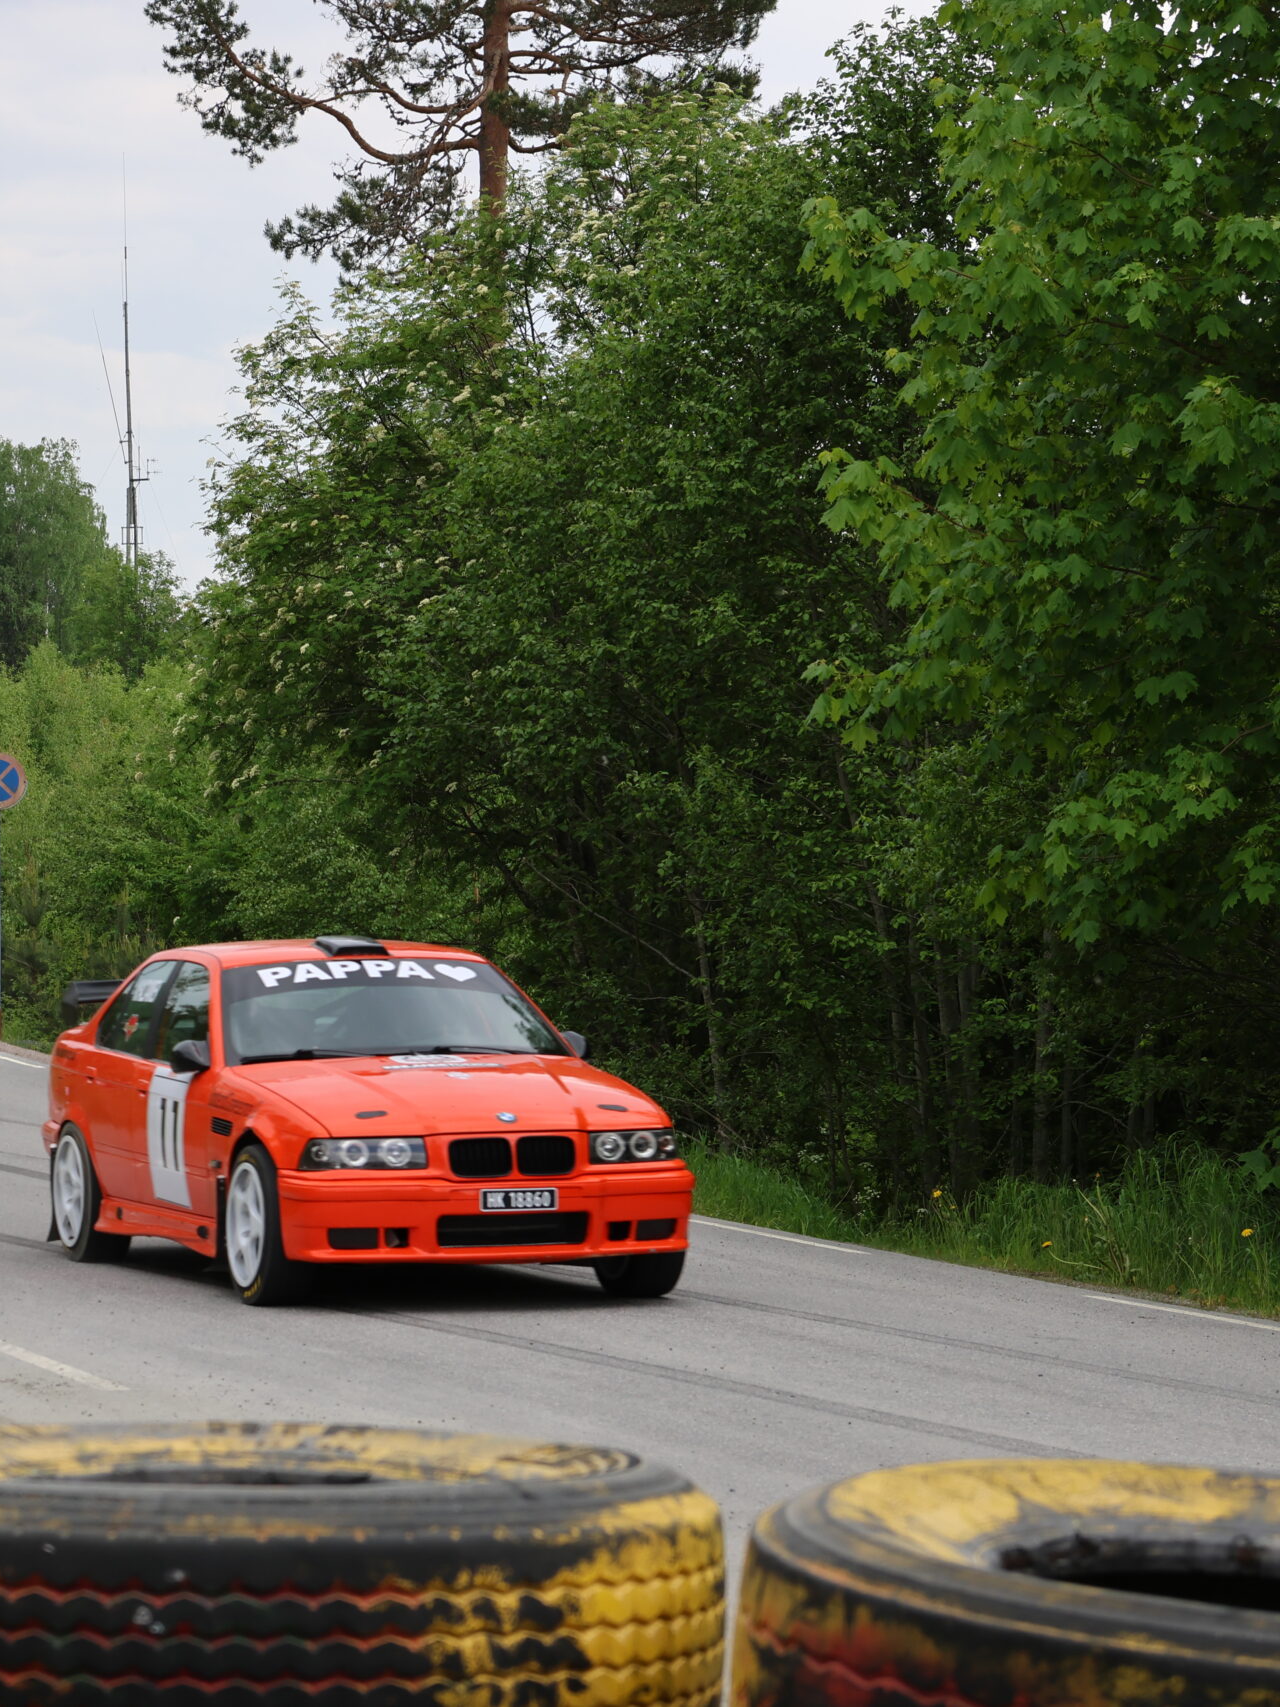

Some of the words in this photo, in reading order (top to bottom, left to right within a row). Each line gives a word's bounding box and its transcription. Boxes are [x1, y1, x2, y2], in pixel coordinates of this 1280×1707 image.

[256, 960, 436, 988] PAPPA
[160, 1097, 180, 1172] 11
[508, 1191, 552, 1208] 18860
